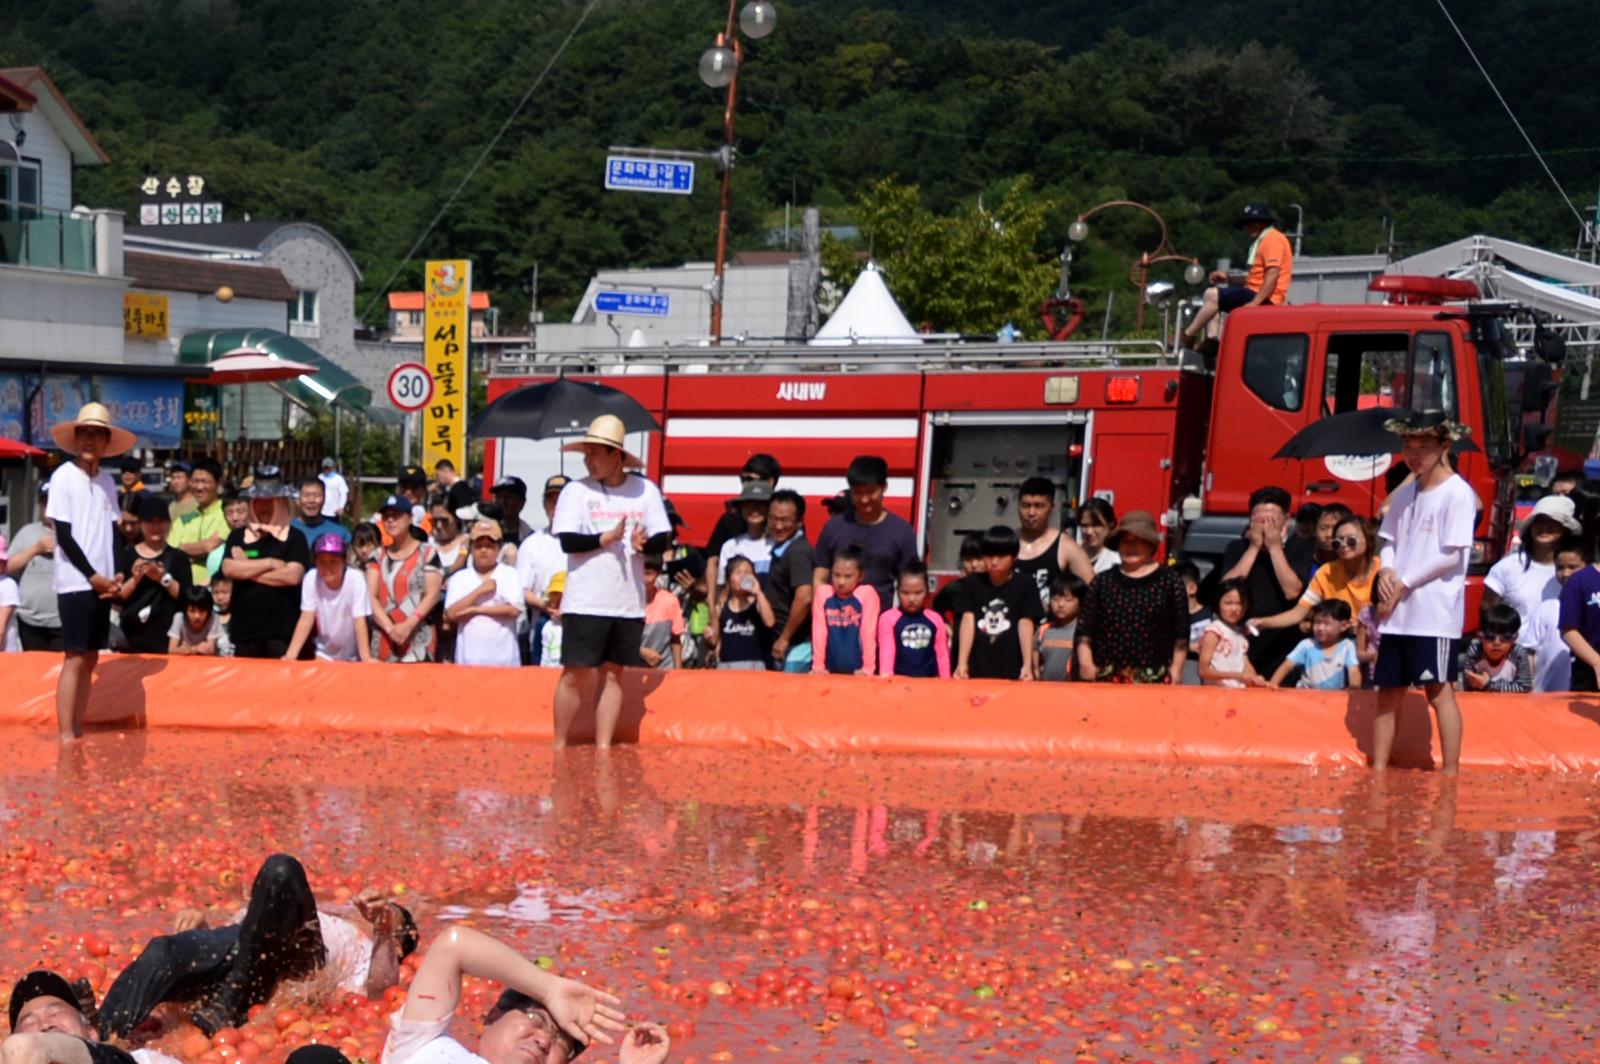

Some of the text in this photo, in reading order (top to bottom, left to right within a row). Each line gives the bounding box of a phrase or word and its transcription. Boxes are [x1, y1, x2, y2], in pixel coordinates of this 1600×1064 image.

[141, 176, 205, 198] 산수장
[398, 375, 423, 398] 30
[431, 324, 460, 453] 섬뜰마루
